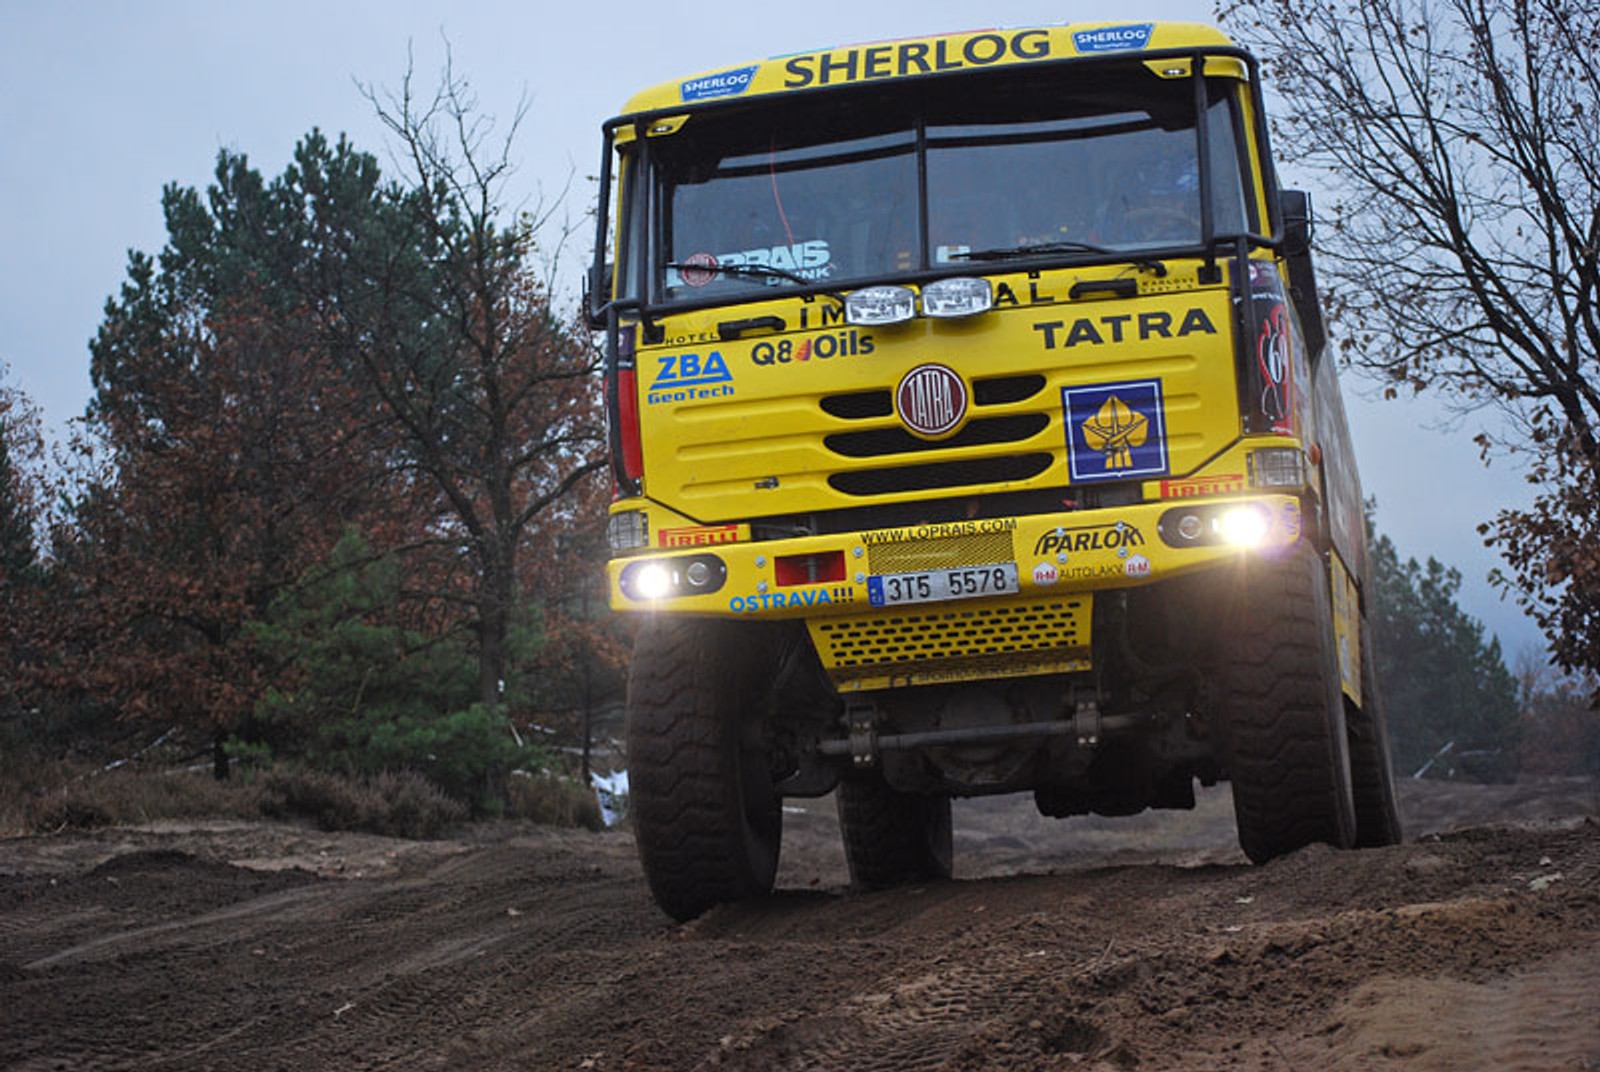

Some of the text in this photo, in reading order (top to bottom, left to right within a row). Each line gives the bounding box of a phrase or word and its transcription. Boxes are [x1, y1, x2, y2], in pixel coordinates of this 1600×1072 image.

[1077, 29, 1146, 43] SHERLOG
[784, 28, 1050, 88] SHERLOG
[684, 74, 749, 92] SHERLOG
[665, 333, 718, 345] HOTEL
[1033, 308, 1217, 349] TATRA
[751, 330, 875, 365] Q8 Oils
[655, 351, 733, 381] ZBA
[908, 369, 954, 428] TATRA
[1160, 474, 1244, 498] PIRELLI
[659, 524, 738, 548] PIRELLI
[861, 518, 1018, 544] WWW.LOPRAIS.COM
[1041, 527, 1142, 555] PARLOK
[1060, 563, 1123, 578] AUTOLAKY
[888, 575, 931, 601] 3T5
[948, 568, 1007, 596] 5578
[730, 587, 854, 613] OSTRAVA!!!
